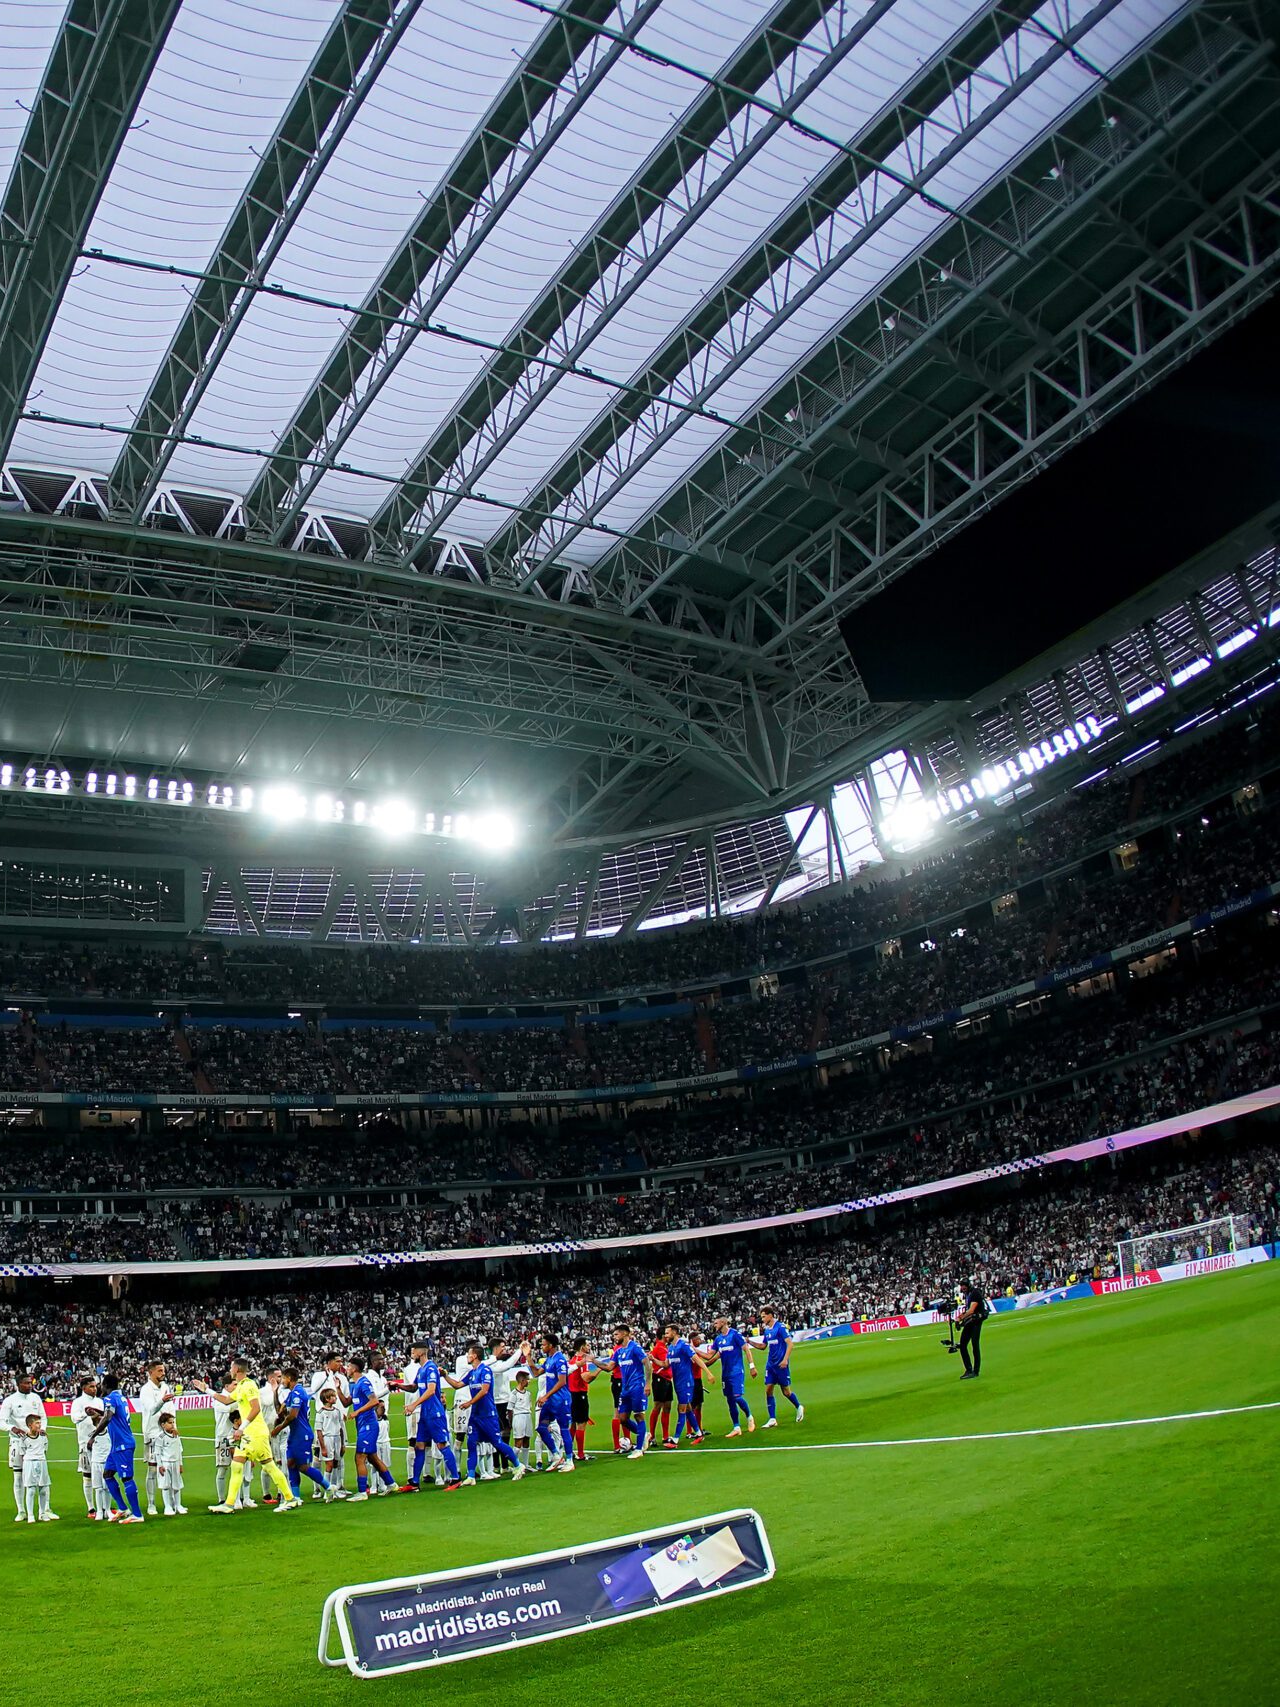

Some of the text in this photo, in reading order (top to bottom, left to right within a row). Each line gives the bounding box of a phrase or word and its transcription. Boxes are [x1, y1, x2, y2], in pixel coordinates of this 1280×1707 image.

[1210, 897, 1252, 920] Real Madrid
[1054, 962, 1093, 982] Real Madrid
[908, 1023, 922, 1032] Real
[758, 1059, 798, 1073] Real Madrid
[10, 1094, 39, 1102] Madrid
[86, 1094, 134, 1104] Real Madrid
[180, 1096, 226, 1104] Real Madrid
[271, 1096, 288, 1104] Real
[1185, 1254, 1236, 1276] FLY EMIRATES
[1101, 1274, 1150, 1294] Emrates
[860, 1320, 900, 1334] Emirates
[178, 1395, 214, 1410] EMIRATE
[458, 1416, 466, 1425] 22
[220, 1448, 230, 1458] 20
[380, 1580, 546, 1622] Hazte Madridista. Join for Real
[375, 1599, 562, 1652] madridistas.com
